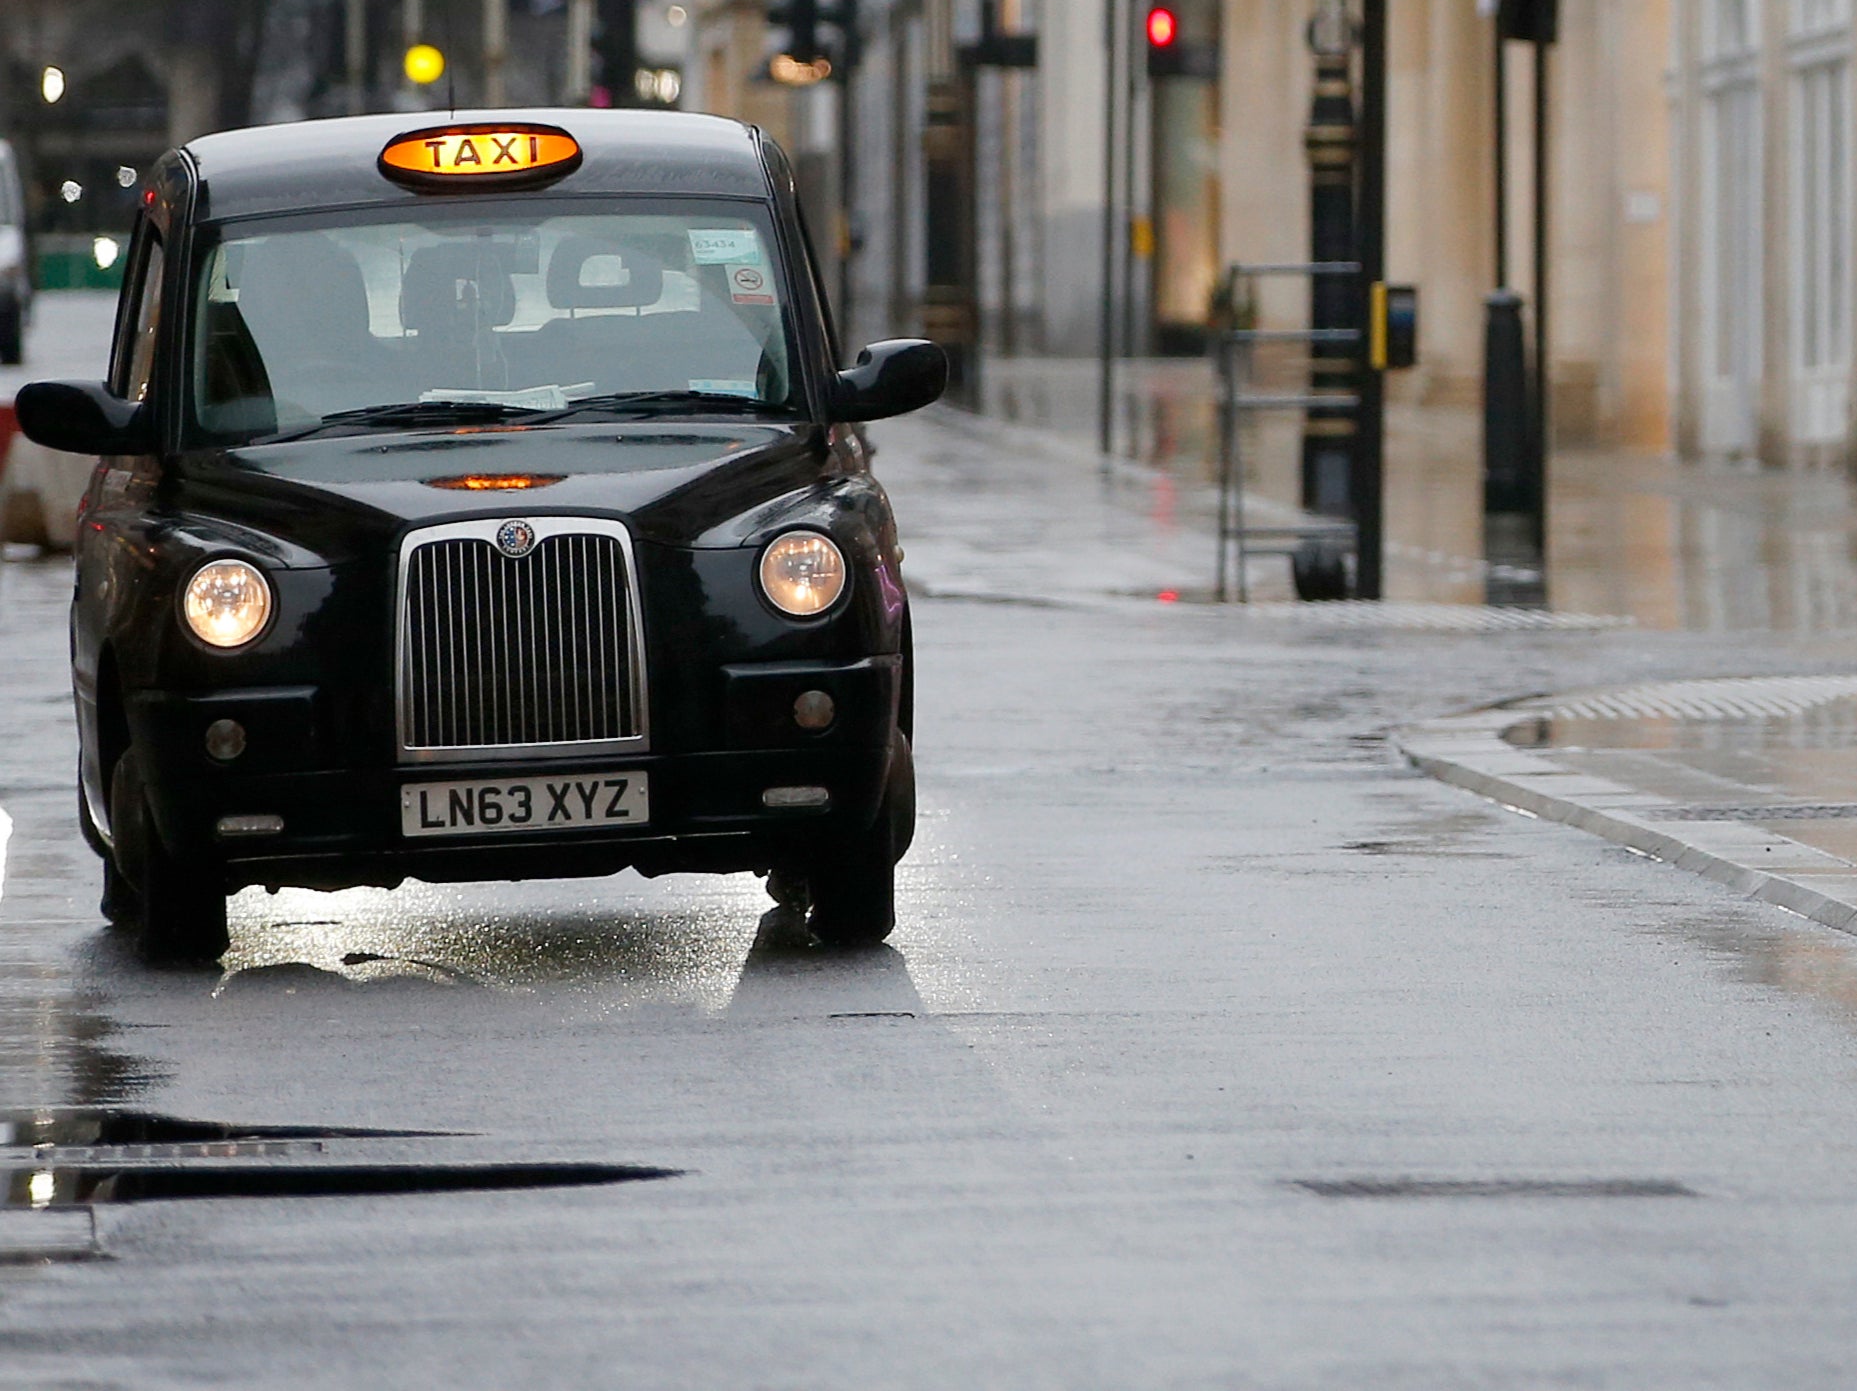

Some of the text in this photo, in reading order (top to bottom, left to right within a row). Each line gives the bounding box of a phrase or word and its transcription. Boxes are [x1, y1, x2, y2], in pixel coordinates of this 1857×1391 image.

[425, 136, 538, 168] TAXI
[419, 779, 629, 829] LN63 XYZ
